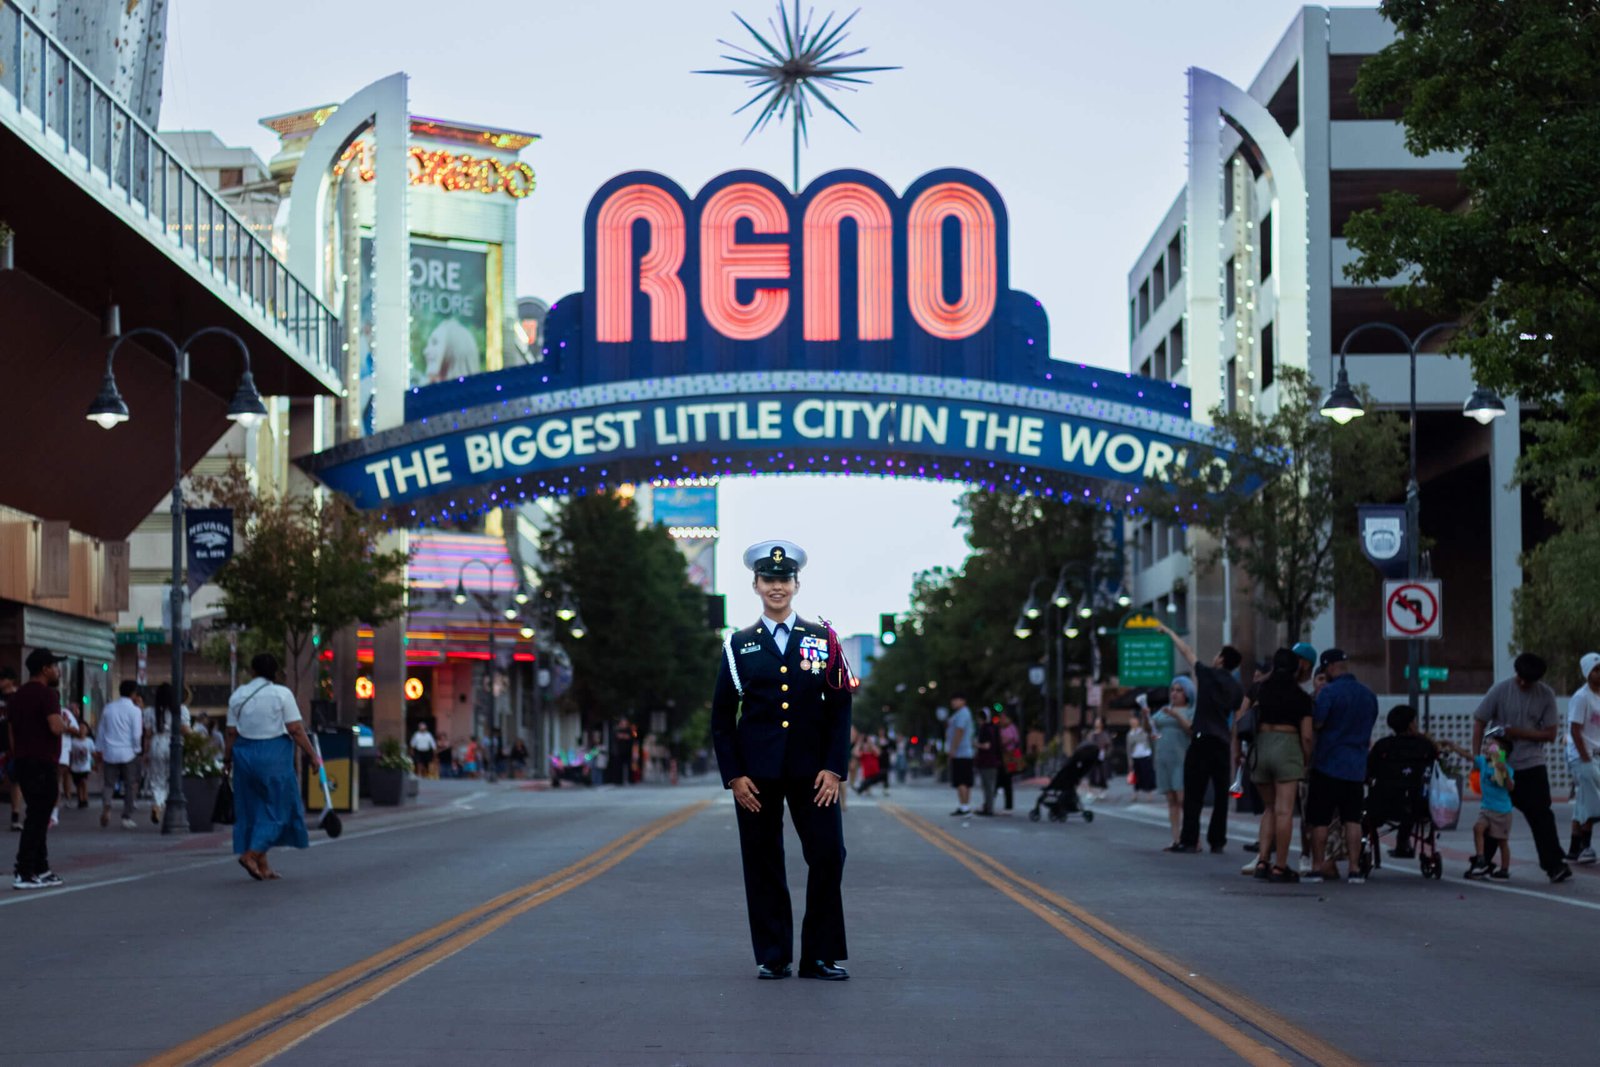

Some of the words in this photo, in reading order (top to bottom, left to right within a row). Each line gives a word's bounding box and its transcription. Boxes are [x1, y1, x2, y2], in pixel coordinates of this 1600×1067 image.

[410, 256, 462, 291] ORE
[596, 181, 997, 343] RENO
[410, 289, 475, 318] XPLORE
[365, 443, 453, 499] THE
[464, 410, 642, 474] BIGGEST
[654, 401, 783, 446] LITTLE
[793, 398, 889, 441] CITY
[899, 404, 949, 445] IN
[960, 409, 1044, 457] THE
[188, 520, 231, 537] NEVADA
